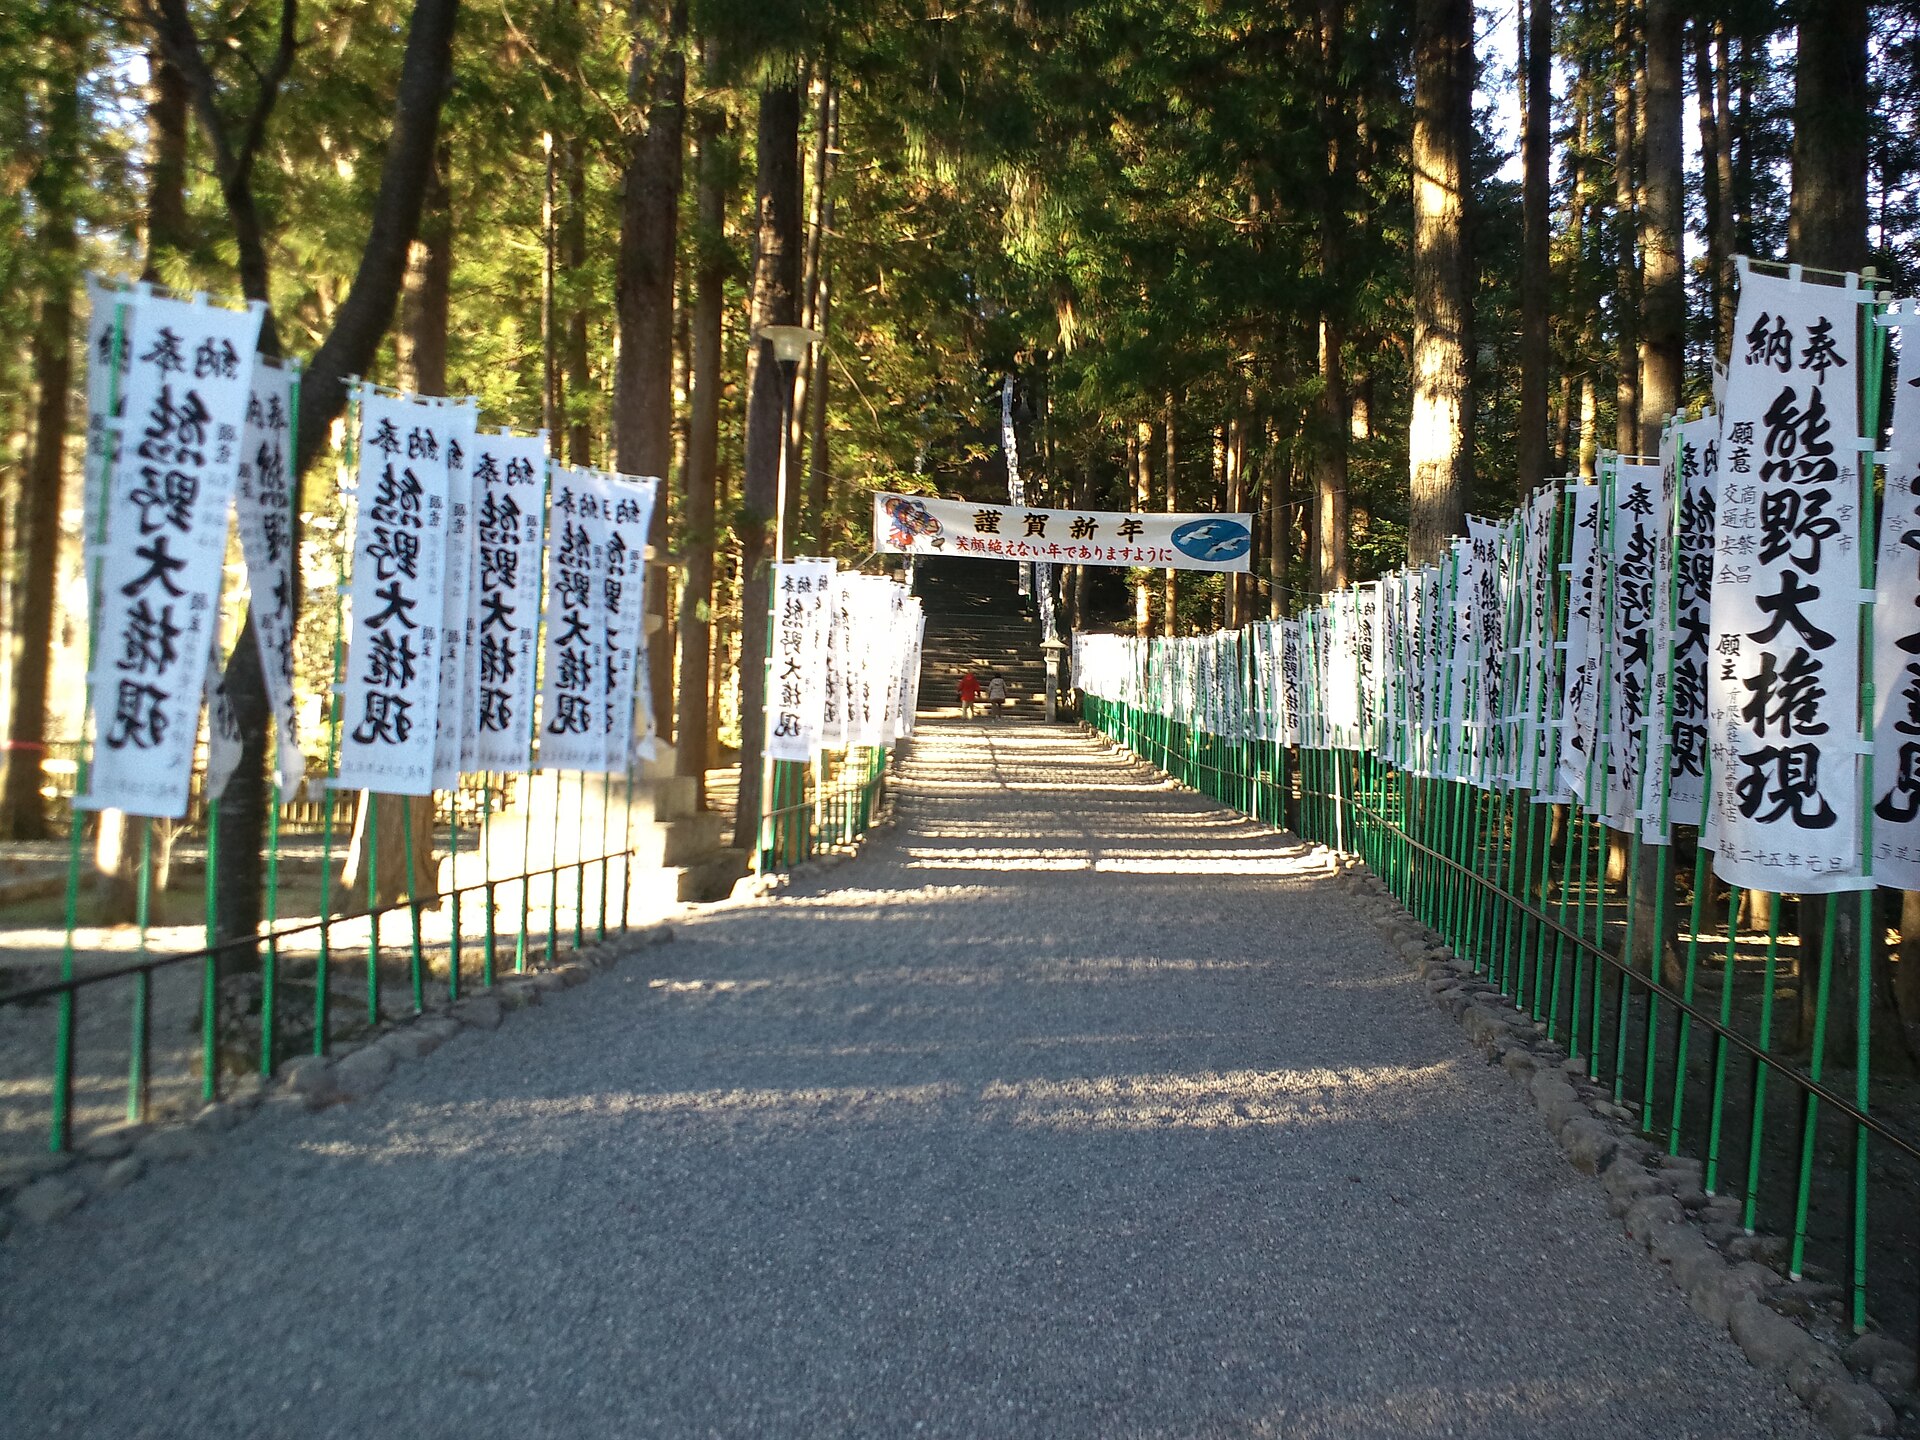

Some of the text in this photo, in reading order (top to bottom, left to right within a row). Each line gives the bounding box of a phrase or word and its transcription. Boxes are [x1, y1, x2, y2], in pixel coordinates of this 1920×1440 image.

[1727, 421, 1755, 474] 願意
[955, 535, 1173, 564] 笑顔絶えない年でありますように
[972, 509, 1145, 544] 謹賀新年
[1716, 483, 1741, 585] 交通安全
[1734, 385, 1841, 830] 熊野大権現
[1715, 633, 1742, 681] 願主
